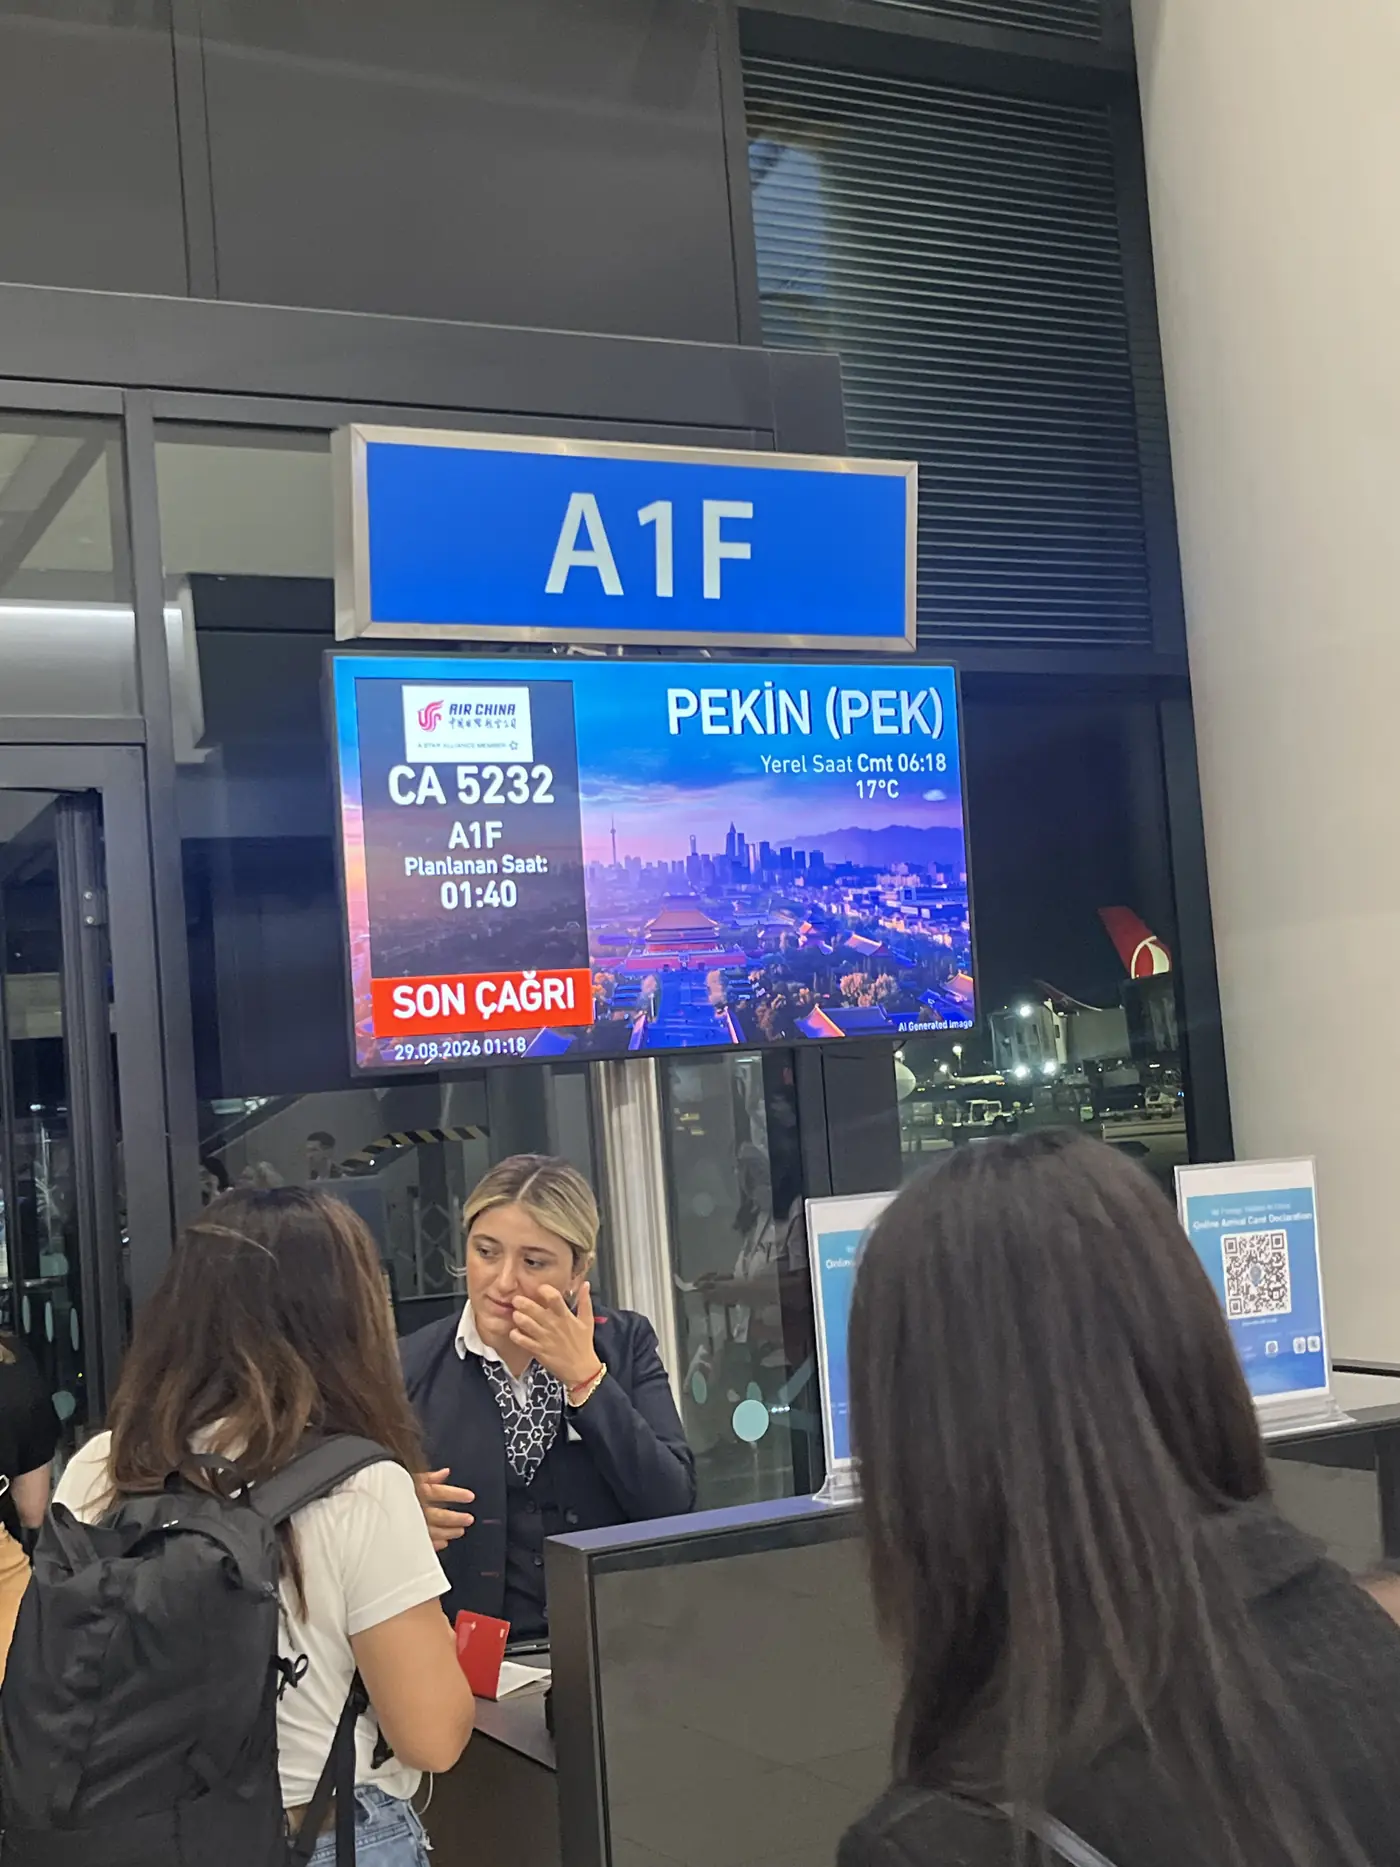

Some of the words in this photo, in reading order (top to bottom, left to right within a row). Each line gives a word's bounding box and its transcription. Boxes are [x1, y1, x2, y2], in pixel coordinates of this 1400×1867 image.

[544, 491, 754, 599] A1F
[449, 703, 472, 716] AIR
[475, 703, 516, 716] CHINA
[666, 681, 811, 735] PEKİN
[825, 686, 944, 740] (PEK)
[760, 755, 807, 773] Yerel
[813, 755, 853, 773] Saat
[857, 754, 893, 773] Cmt
[898, 753, 947, 772] 06:18
[388, 764, 447, 806] CA
[456, 764, 555, 805] 5232
[856, 779, 899, 799] 17°C
[448, 820, 503, 849] A1F
[404, 856, 498, 876] Planlanan
[502, 854, 548, 873] Saat:
[440, 879, 517, 909] 01:40
[392, 982, 466, 1019] SON
[475, 970, 575, 1020] ÇAĞRI
[898, 1022, 907, 1032] AI
[908, 1021, 948, 1031] Generated
[394, 1042, 481, 1061] 29.08.2026
[484, 1036, 527, 1054] 01:18
